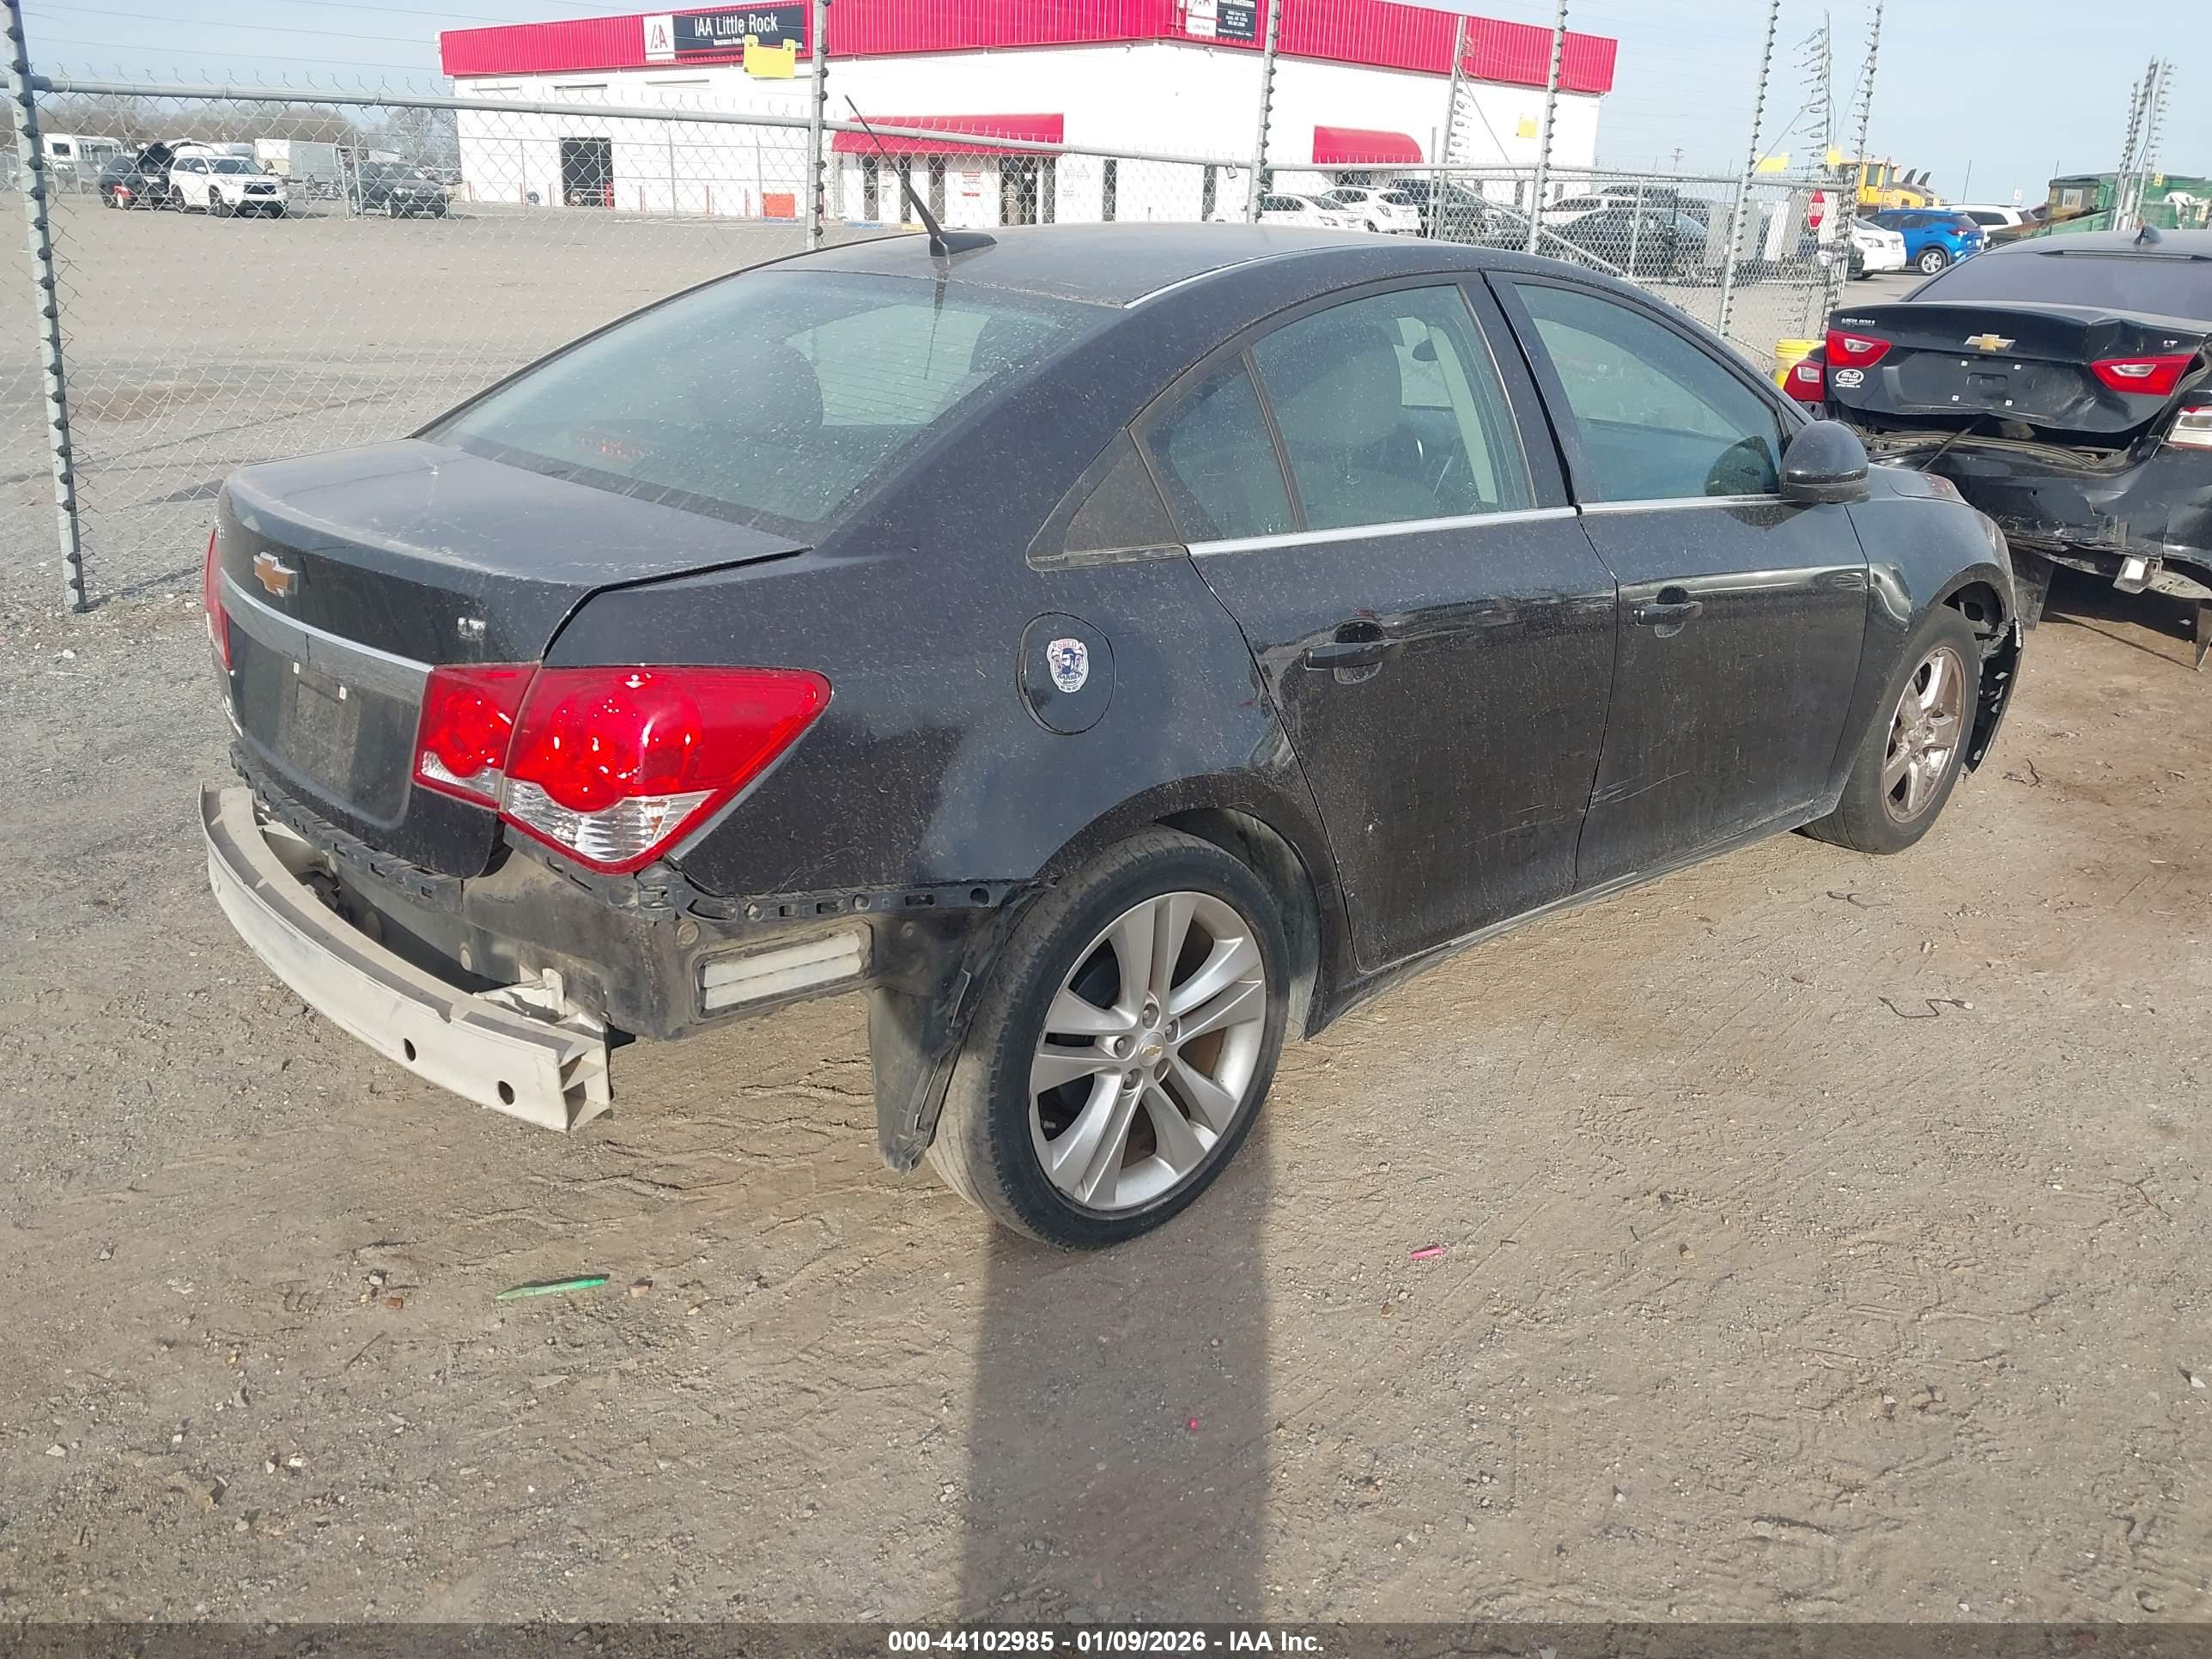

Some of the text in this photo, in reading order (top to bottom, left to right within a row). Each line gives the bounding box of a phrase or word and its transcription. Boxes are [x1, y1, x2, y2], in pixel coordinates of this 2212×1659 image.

[694, 11, 779, 37] IAA Little Rock
[1808, 202, 1825, 217] STOP
[1840, 317, 1876, 327] MALIBU
[2163, 339, 2179, 349] LT
